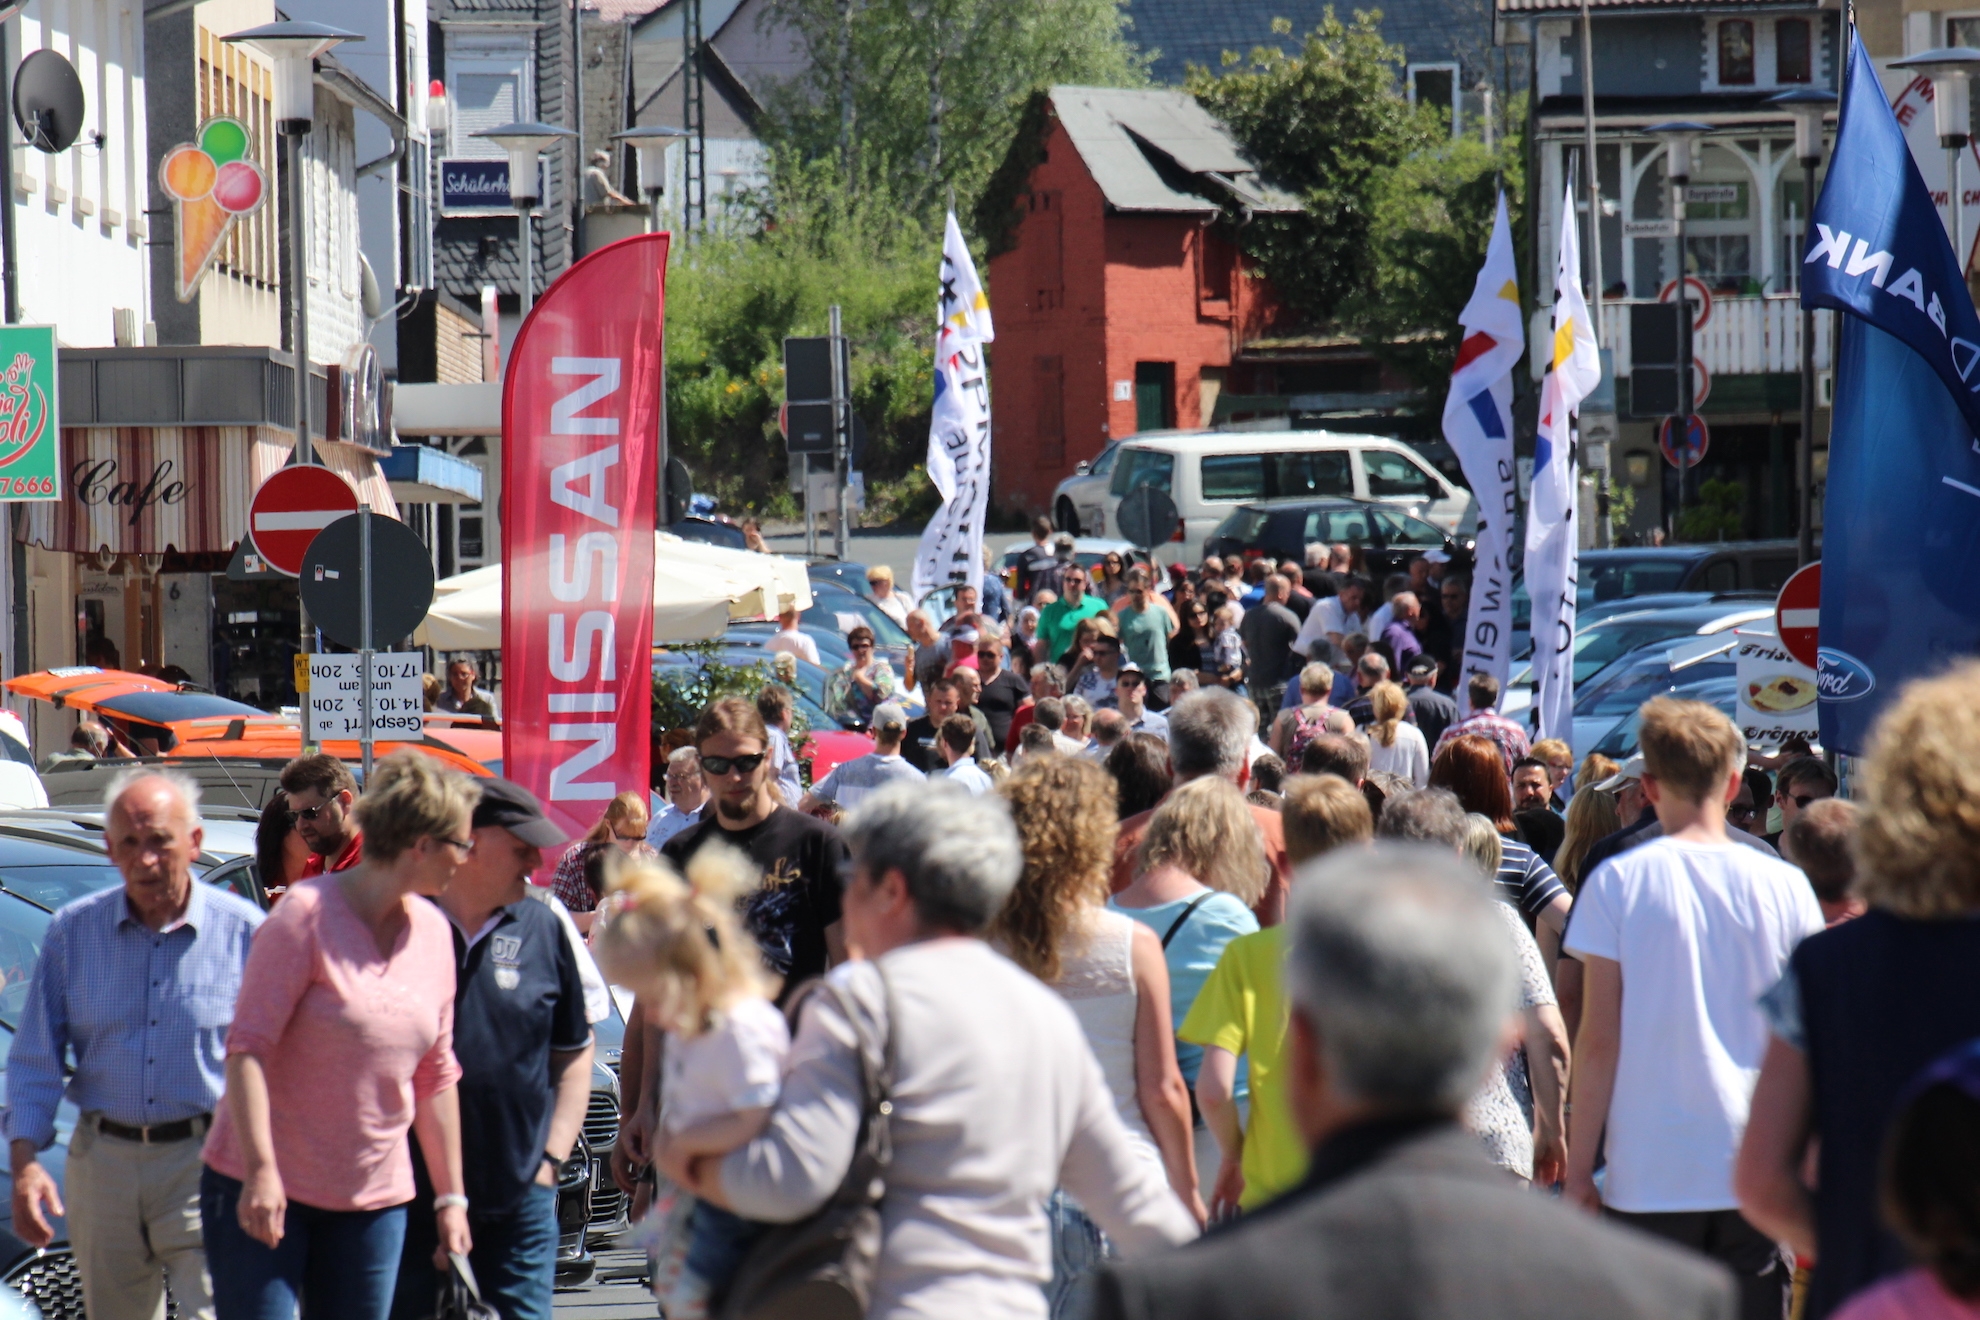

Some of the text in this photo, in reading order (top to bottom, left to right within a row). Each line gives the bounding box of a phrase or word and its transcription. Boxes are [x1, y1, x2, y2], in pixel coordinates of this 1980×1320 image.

[71, 459, 196, 526] Cafe
[547, 357, 622, 801] NISSAN
[169, 581, 181, 600] 6
[311, 665, 342, 678] 20h
[339, 681, 359, 690] am
[313, 699, 344, 712] 20h
[319, 720, 333, 731] ab
